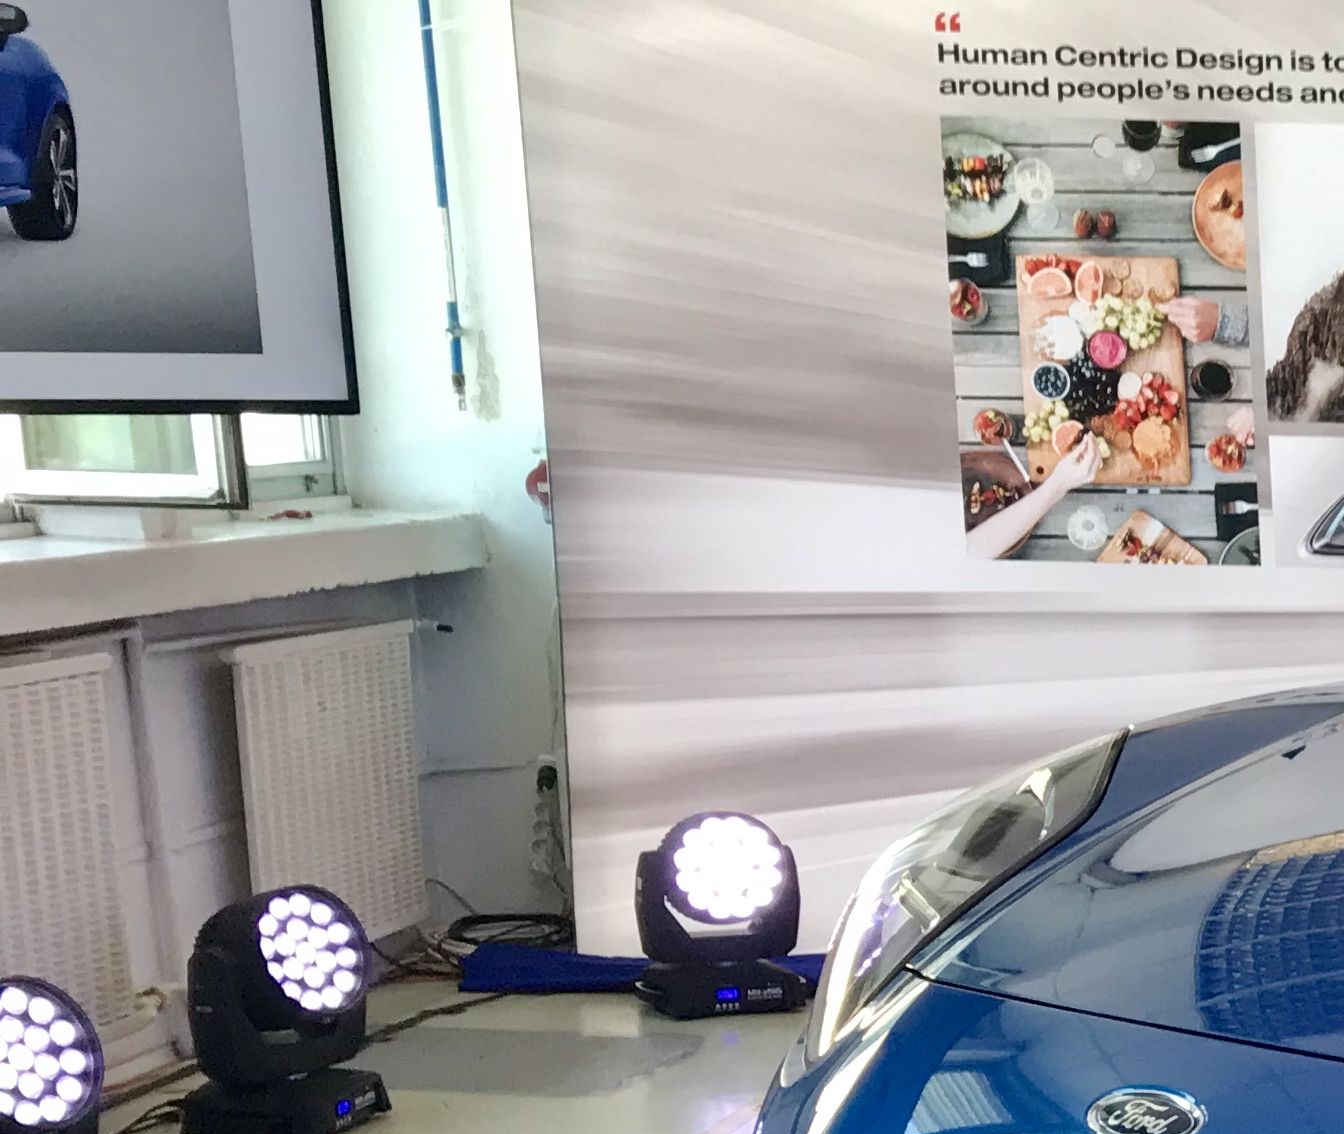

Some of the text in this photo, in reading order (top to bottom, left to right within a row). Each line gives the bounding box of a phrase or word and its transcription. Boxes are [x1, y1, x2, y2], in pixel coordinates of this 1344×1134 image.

[937, 43, 1048, 65] Human
[1054, 45, 1169, 69] Centric
[1176, 48, 1283, 76] Design
[1290, 50, 1315, 72] is
[939, 77, 1050, 98] around
[1057, 78, 1191, 104] people’s
[1197, 81, 1294, 103] needs
